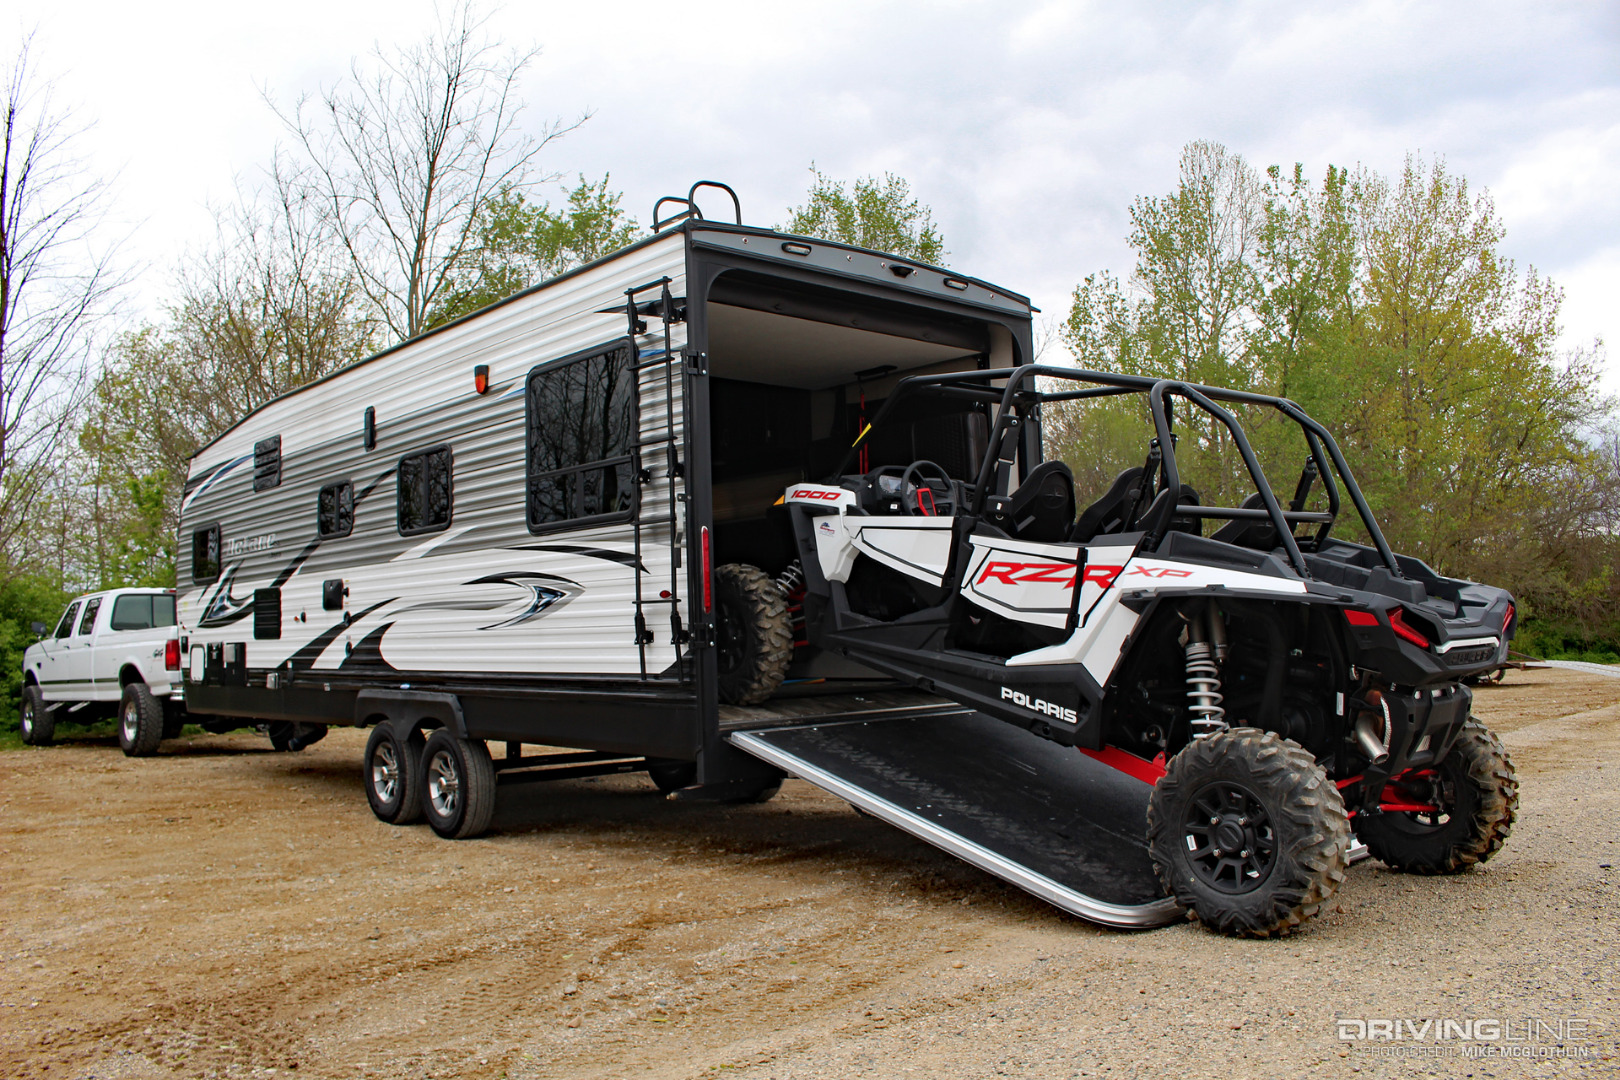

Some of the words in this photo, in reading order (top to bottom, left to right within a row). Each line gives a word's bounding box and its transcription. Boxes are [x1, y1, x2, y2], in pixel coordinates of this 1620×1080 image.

[791, 489, 841, 501] 1000
[976, 561, 1124, 590] RZR
[1127, 565, 1195, 578] XP
[1000, 686, 1077, 724] POLARIS
